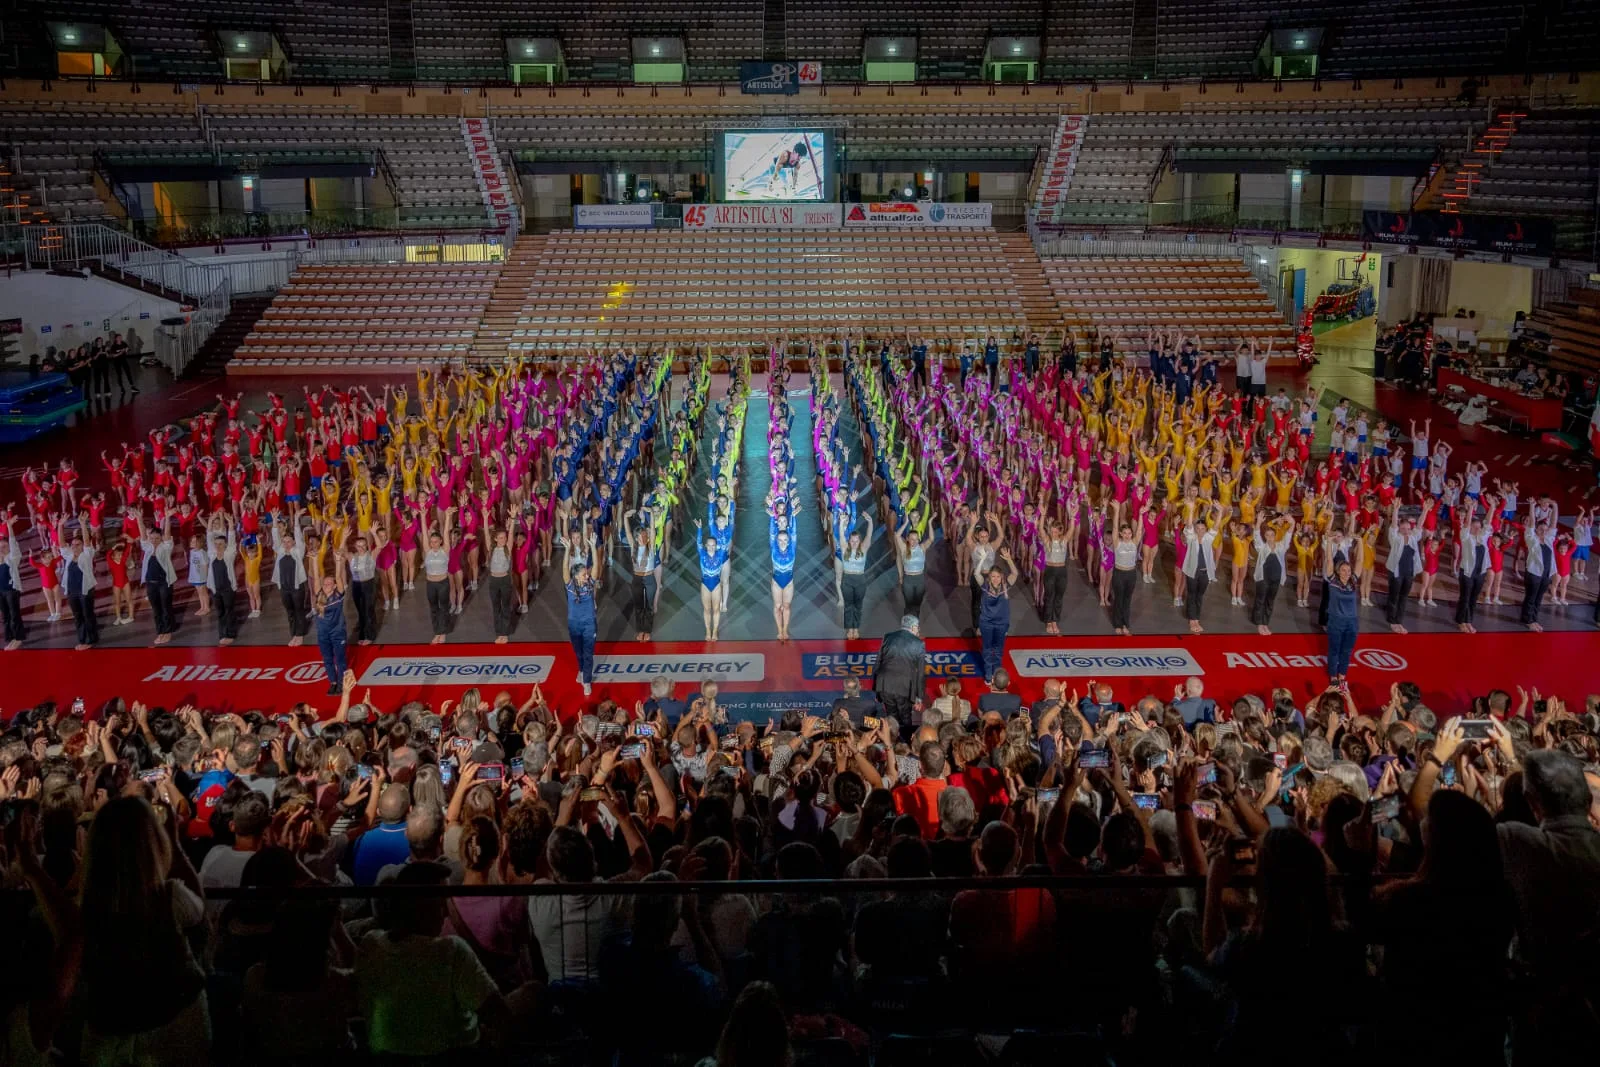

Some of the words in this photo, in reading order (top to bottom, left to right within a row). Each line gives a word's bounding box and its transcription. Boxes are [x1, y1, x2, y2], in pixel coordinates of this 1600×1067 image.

[747, 81, 783, 89] ARTISTICA
[685, 206, 706, 226] 45
[714, 206, 776, 224] ARTISTICA
[804, 212, 834, 224] TRIESTE
[815, 652, 968, 667] BLUERGY
[1026, 656, 1188, 668] AUTOTORINO
[1223, 651, 1358, 669] Allian
[141, 664, 284, 682] Allianz
[373, 664, 542, 677] AUTOTORINO
[593, 661, 752, 674] BLUENERGY
[813, 664, 977, 678] ASSINCE
[785, 701, 833, 709] VENEZIA
